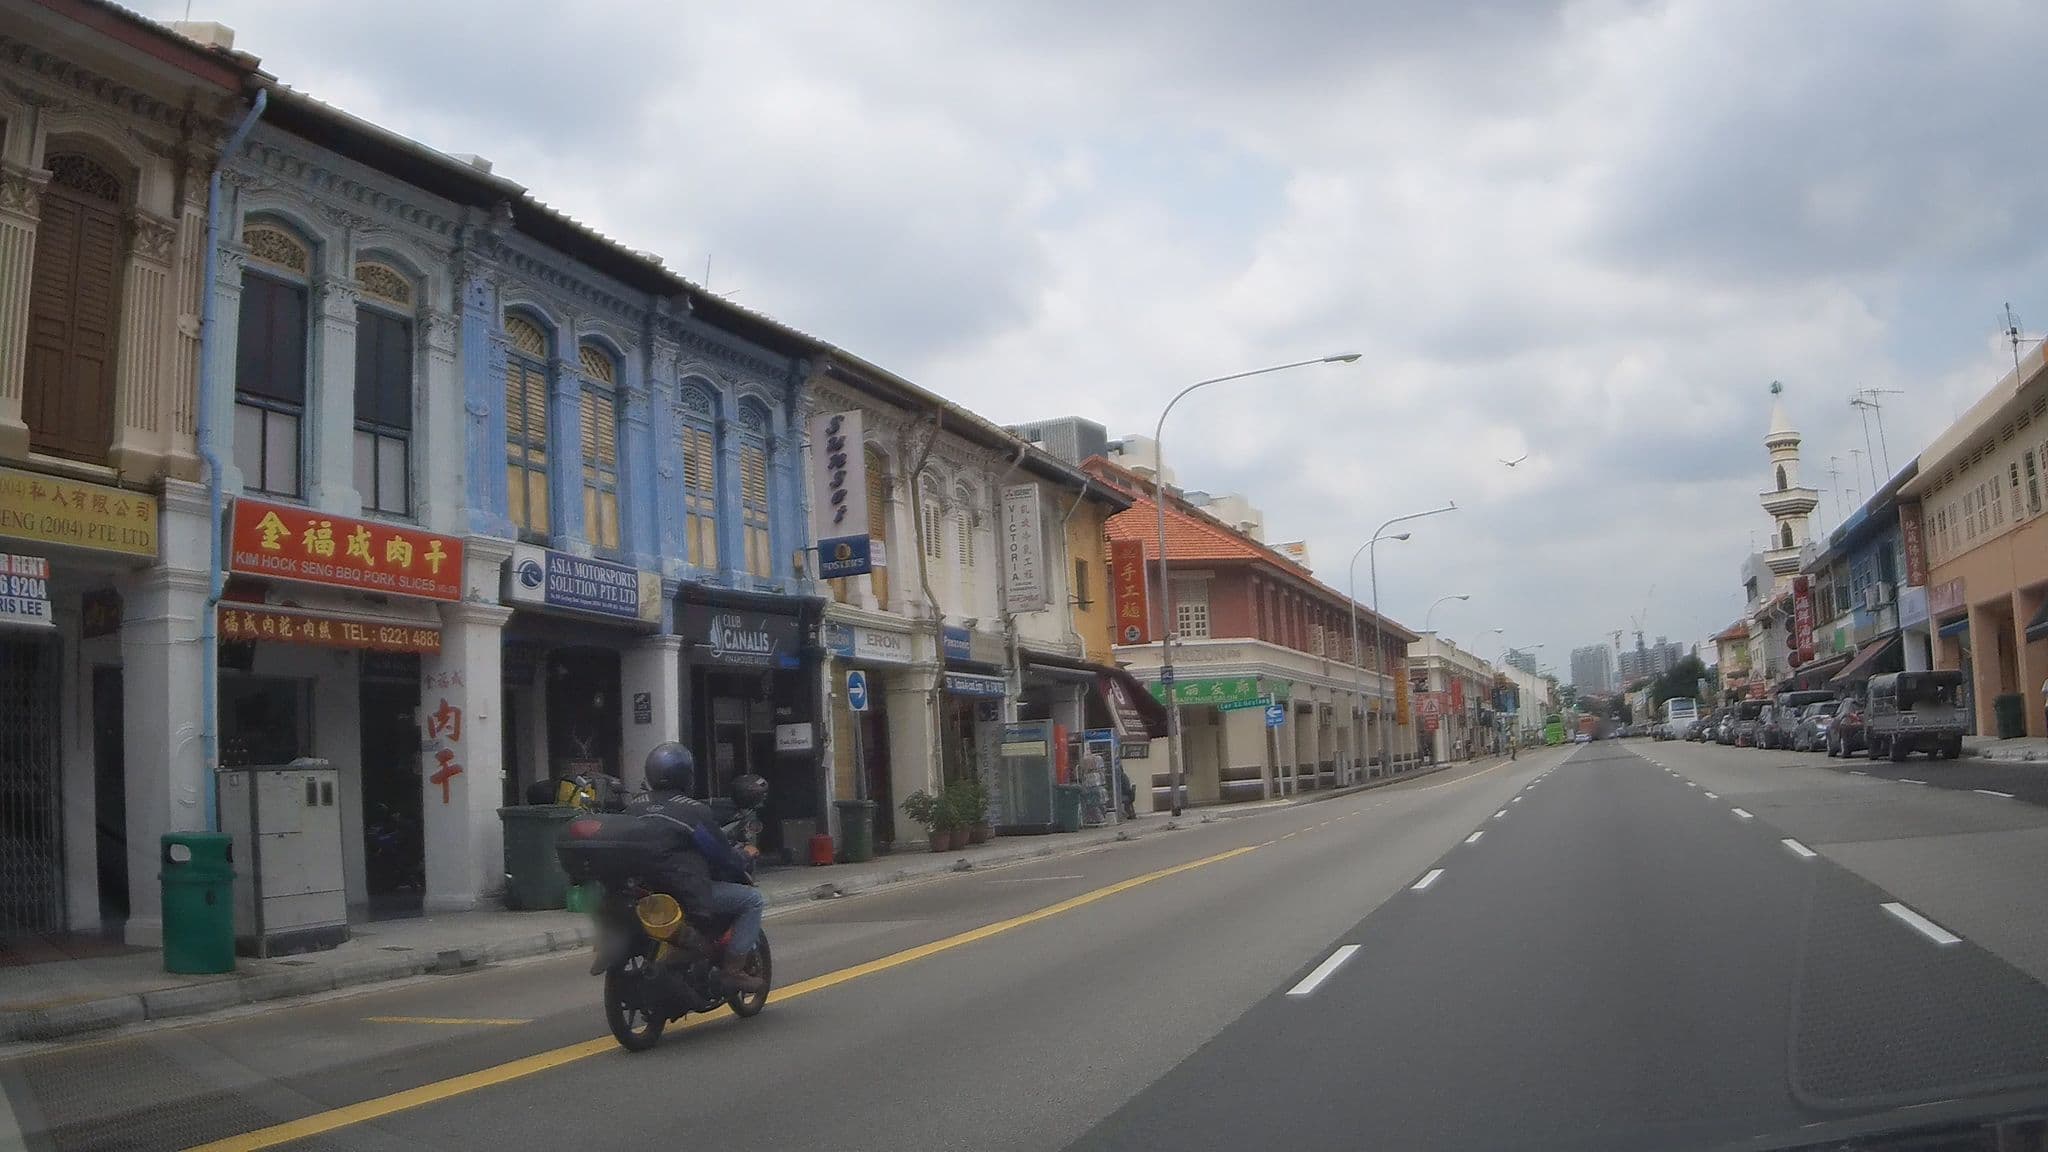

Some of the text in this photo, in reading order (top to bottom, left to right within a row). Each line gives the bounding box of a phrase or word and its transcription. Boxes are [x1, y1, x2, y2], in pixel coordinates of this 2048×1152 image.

[40, 515, 84, 541] (2004)
[88, 521, 116, 542] PTE
[121, 527, 150, 548] LTD
[255, 511, 448, 575] 金福成肉干
[12, 555, 47, 578] RENT
[236, 551, 259, 567] KIM
[261, 554, 298, 572] HOCK
[301, 560, 333, 577] SENG
[335, 566, 361, 581] BBQ
[363, 570, 396, 586] PORK
[398, 575, 436, 592] SLICES
[550, 557, 637, 589] ASIA MOTORSPORTS
[10, 575, 48, 600] 9204
[550, 575, 597, 598] SOLUTION
[600, 584, 618, 602] PTE
[619, 588, 636, 605] LTD
[20, 599, 43, 617] LEE
[723, 614, 742, 628] CLUB
[380, 626, 409, 645] 6221
[412, 630, 441, 647] 4882
[724, 629, 769, 652] CANALIS
